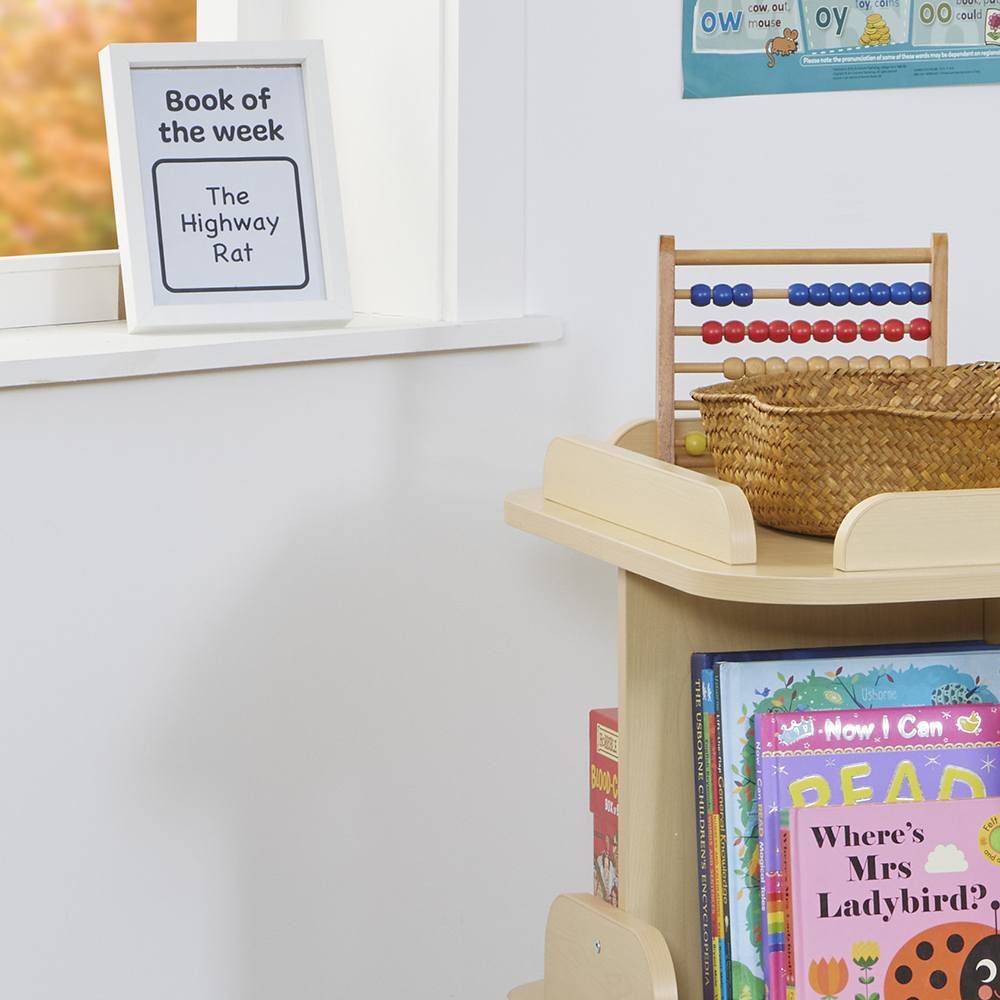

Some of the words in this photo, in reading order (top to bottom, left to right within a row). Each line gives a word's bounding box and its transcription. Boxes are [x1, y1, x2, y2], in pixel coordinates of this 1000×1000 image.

[748, 4, 770, 14] cow,
[772, 2, 790, 13] out,
[815, 6, 848, 35] oy
[919, 2, 952, 24] oo
[956, 9, 982, 20] could
[701, 11, 742, 34] ow
[748, 19, 782, 28] mouse
[842, 55, 876, 63] pronunciation
[981, 49, 1000, 57] regional
[165, 88, 235, 112] Book
[241, 87, 271, 110] of
[158, 120, 205, 143] the
[212, 119, 285, 142] week
[206, 187, 250, 205] The
[181, 213, 279, 239] Highway
[213, 242, 253, 263] Rat
[694, 678, 702, 707] THE
[862, 688, 897, 701] Usborne
[824, 716, 875, 742] Now
[882, 715, 890, 739] I
[898, 714, 944, 739] Can
[696, 712, 704, 781] USBORNE
[718, 776, 726, 831] General
[698, 785, 706, 869] CHILDREN'S
[810, 822, 925, 848] Where's
[983, 816, 998, 832] Felt
[984, 849, 997, 861] and
[720, 835, 728, 904] Knowledge
[846, 855, 912, 882] Mrs
[817, 884, 987, 922] Ladybird?
[701, 874, 710, 986] ENCYCLOPEDIA
